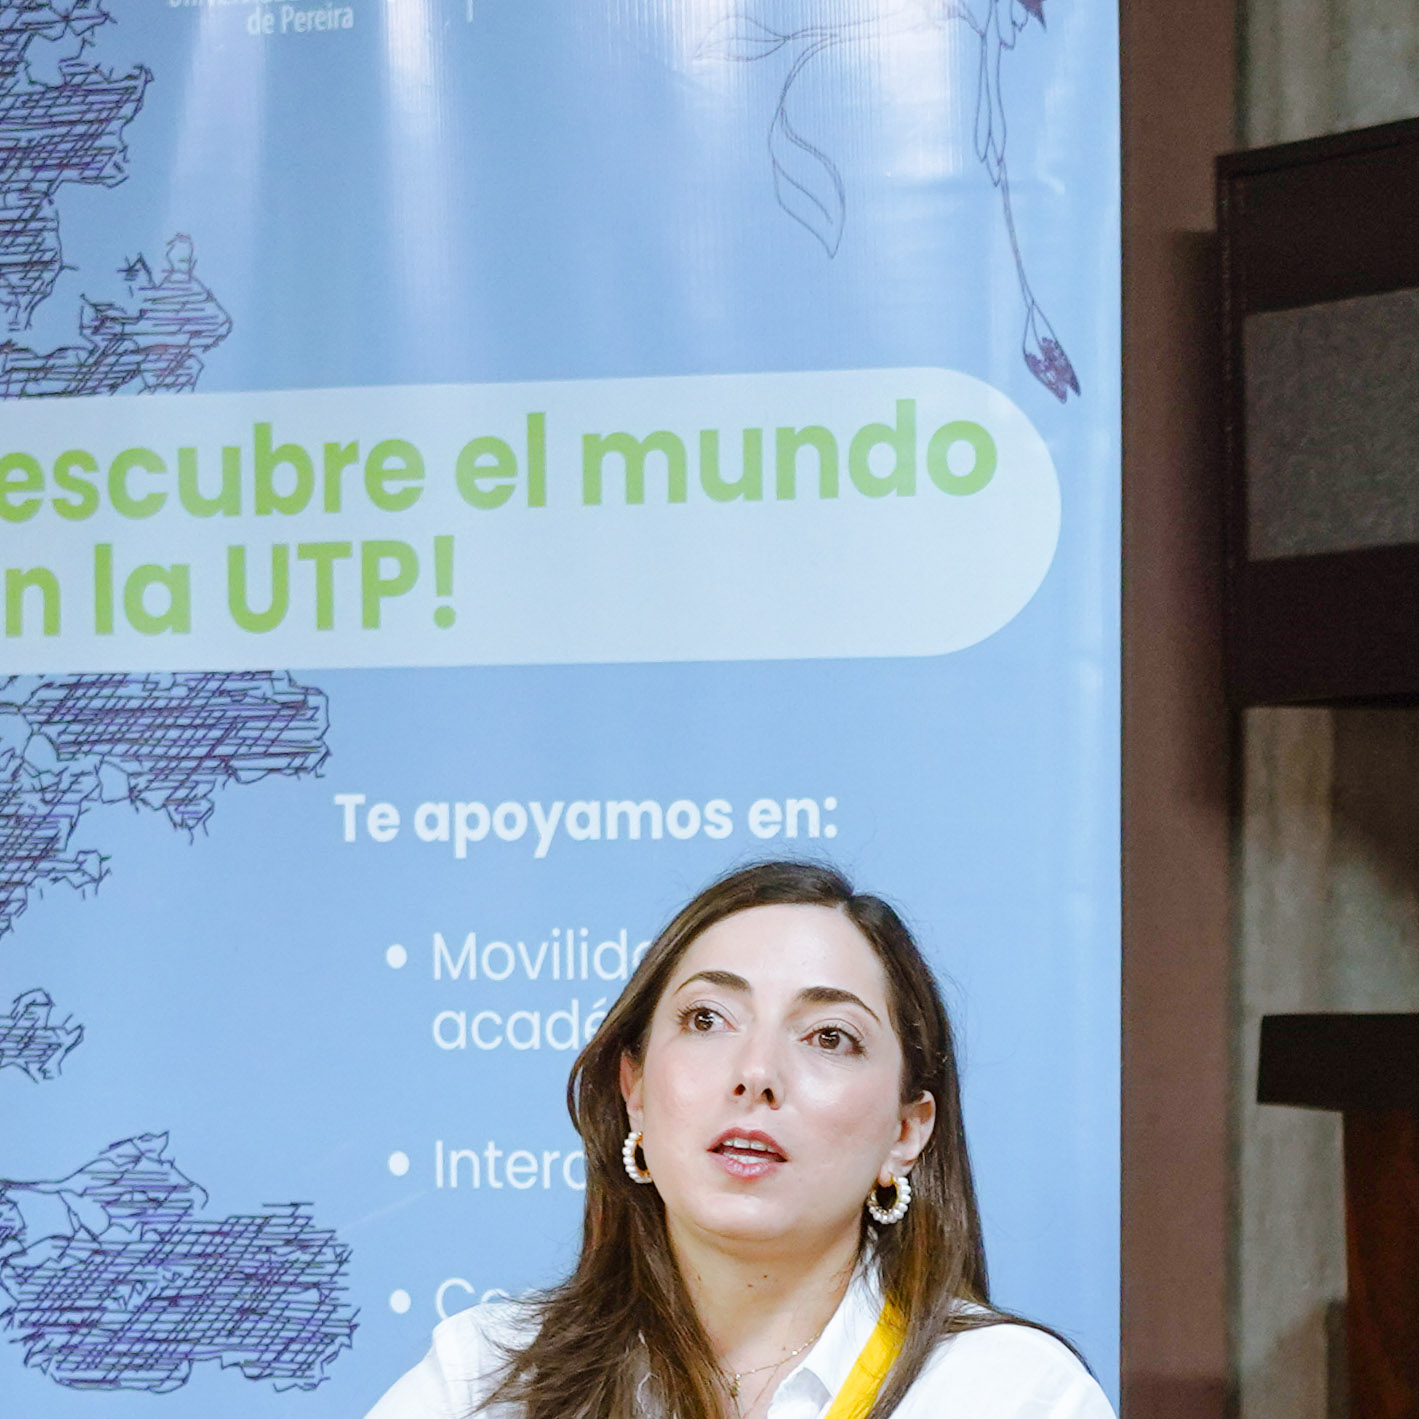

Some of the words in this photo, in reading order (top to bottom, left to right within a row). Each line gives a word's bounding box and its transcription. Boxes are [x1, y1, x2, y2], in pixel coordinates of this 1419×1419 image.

[248, 6, 275, 35] de
[281, 5, 354, 33] Pereira
[0, 422, 425, 523] escubre
[455, 412, 546, 510] el
[583, 399, 998, 505] mundo
[5, 566, 61, 637] n
[94, 542, 191, 636] la
[227, 534, 457, 635] UTP!
[334, 793, 400, 842] Te
[414, 796, 734, 859] apoyamos
[748, 796, 838, 839] en:
